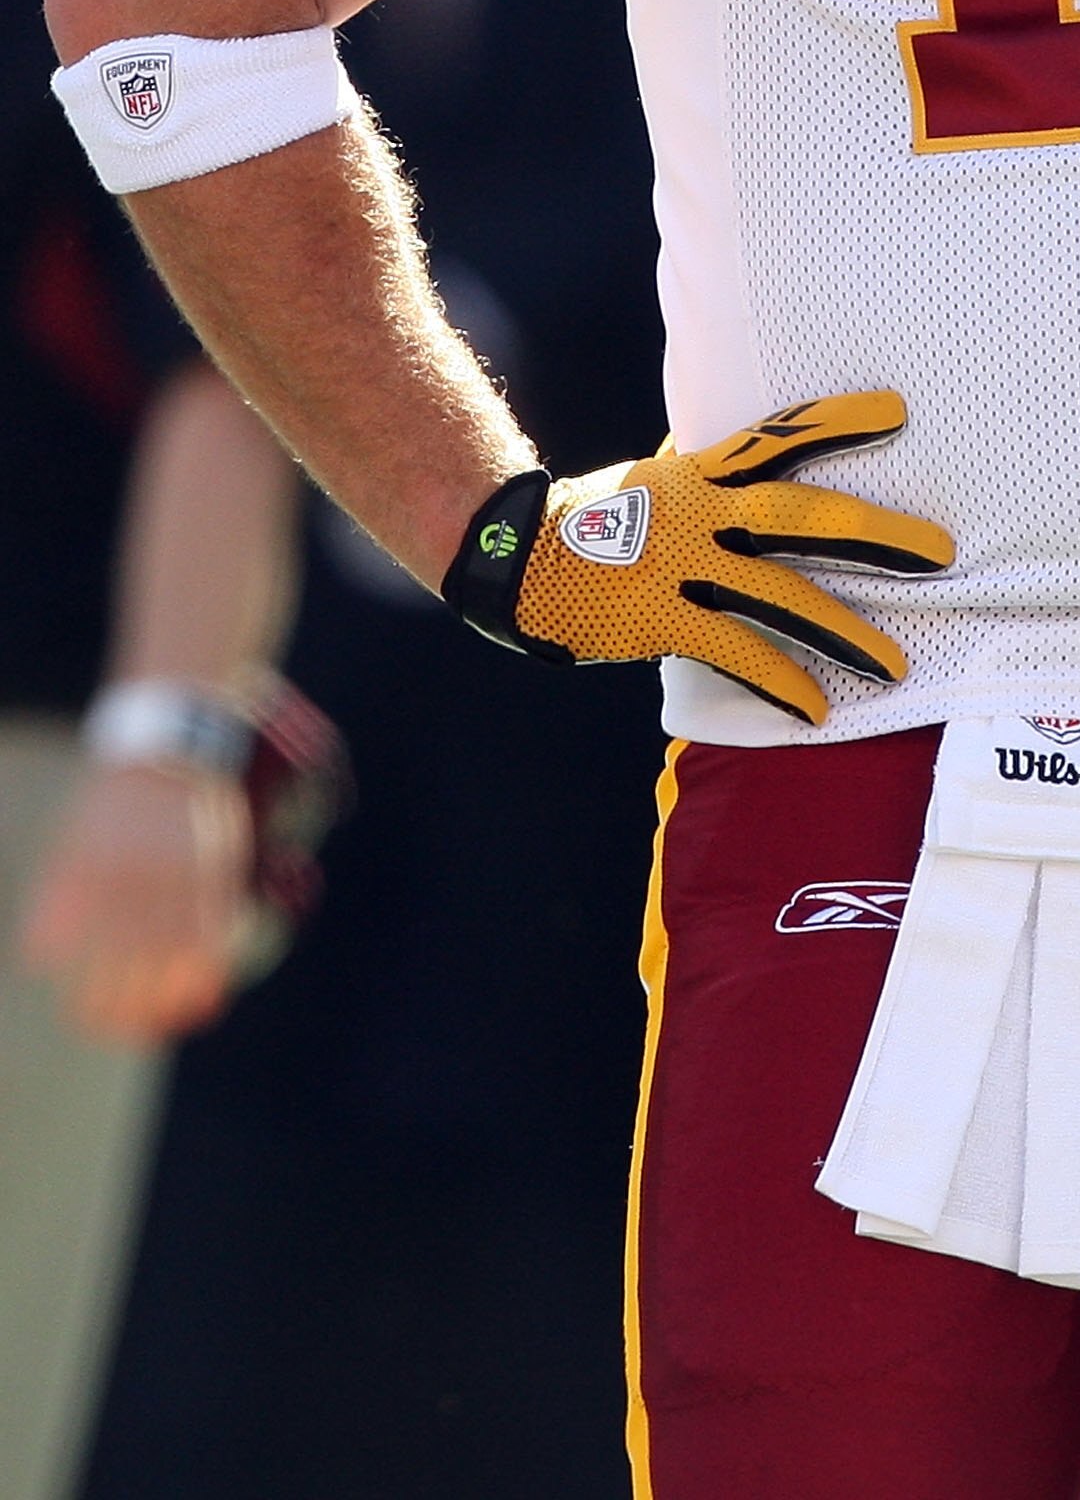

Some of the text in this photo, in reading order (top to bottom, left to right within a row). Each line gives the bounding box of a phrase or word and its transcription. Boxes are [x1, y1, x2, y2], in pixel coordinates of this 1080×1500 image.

[105, 58, 168, 81] EQUIPMENT
[124, 92, 160, 116] NFL
[579, 510, 605, 541] NFL
